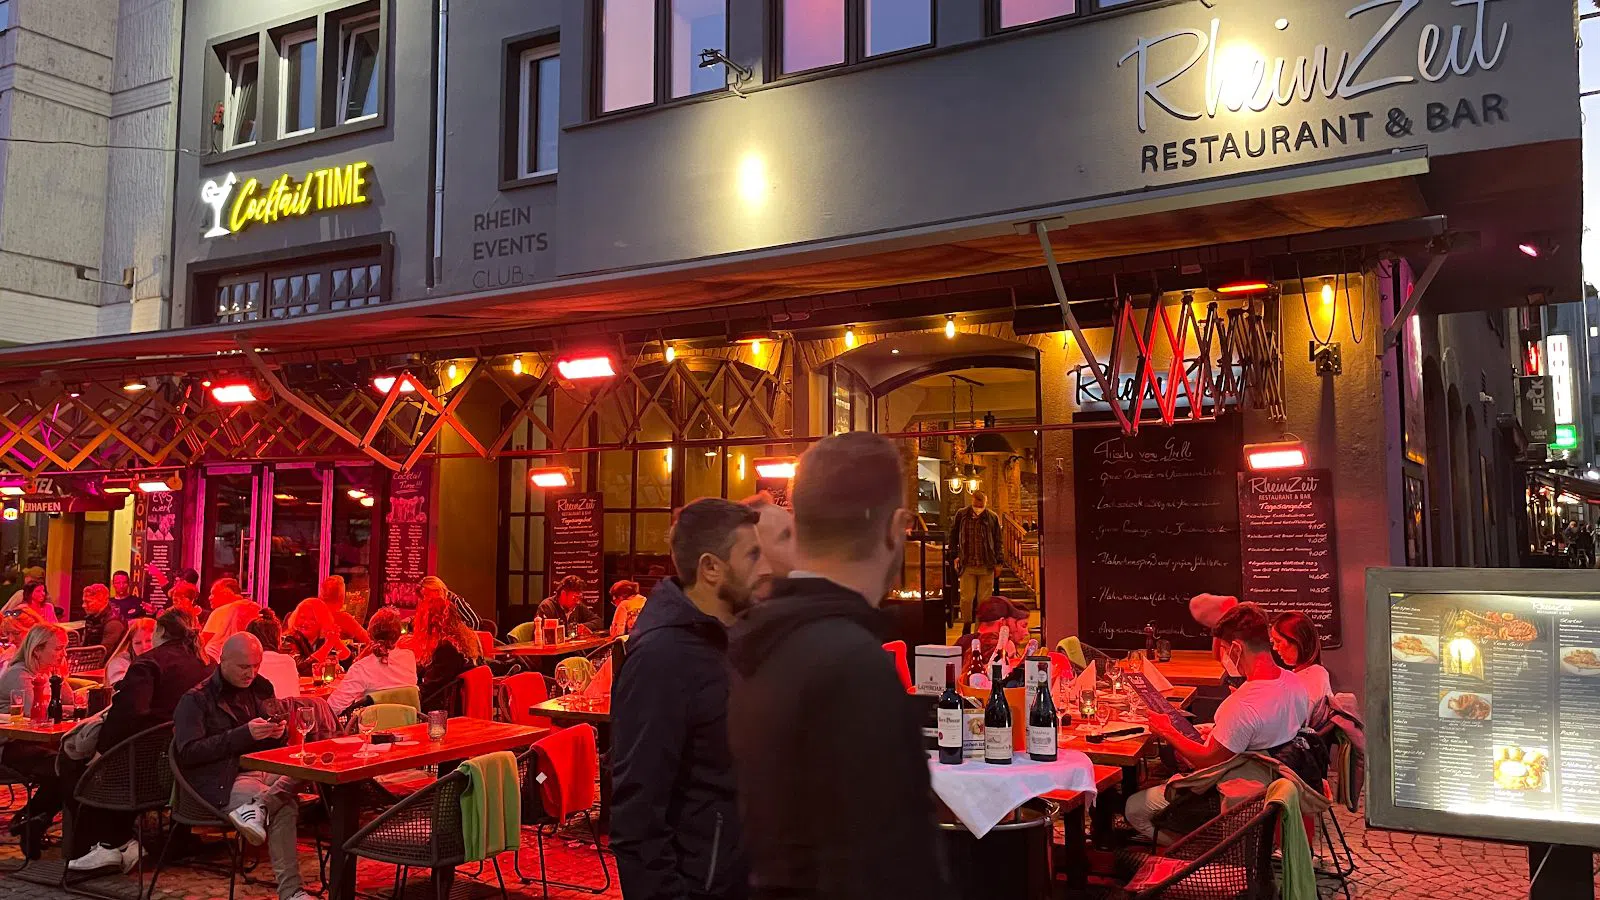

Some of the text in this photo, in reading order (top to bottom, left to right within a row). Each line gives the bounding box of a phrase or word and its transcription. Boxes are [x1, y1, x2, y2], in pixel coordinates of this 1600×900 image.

[1117, 0, 1508, 133] RheinZeit
[1141, 93, 1509, 173] RESTAURANT & BAR
[230, 160, 368, 233] Cocktail TIME
[473, 205, 531, 232] RHEIN
[473, 232, 548, 260] EVENTS
[472, 265, 524, 289] CLUB
[1532, 377, 1546, 415] JECK
[34, 477, 54, 494] TEL
[1247, 476, 1320, 494] RheinZeit
[1258, 493, 1293, 501] RESTAURANT
[24, 501, 62, 512] ERHAFEN
[1258, 501, 1313, 513] Tagesangebot
